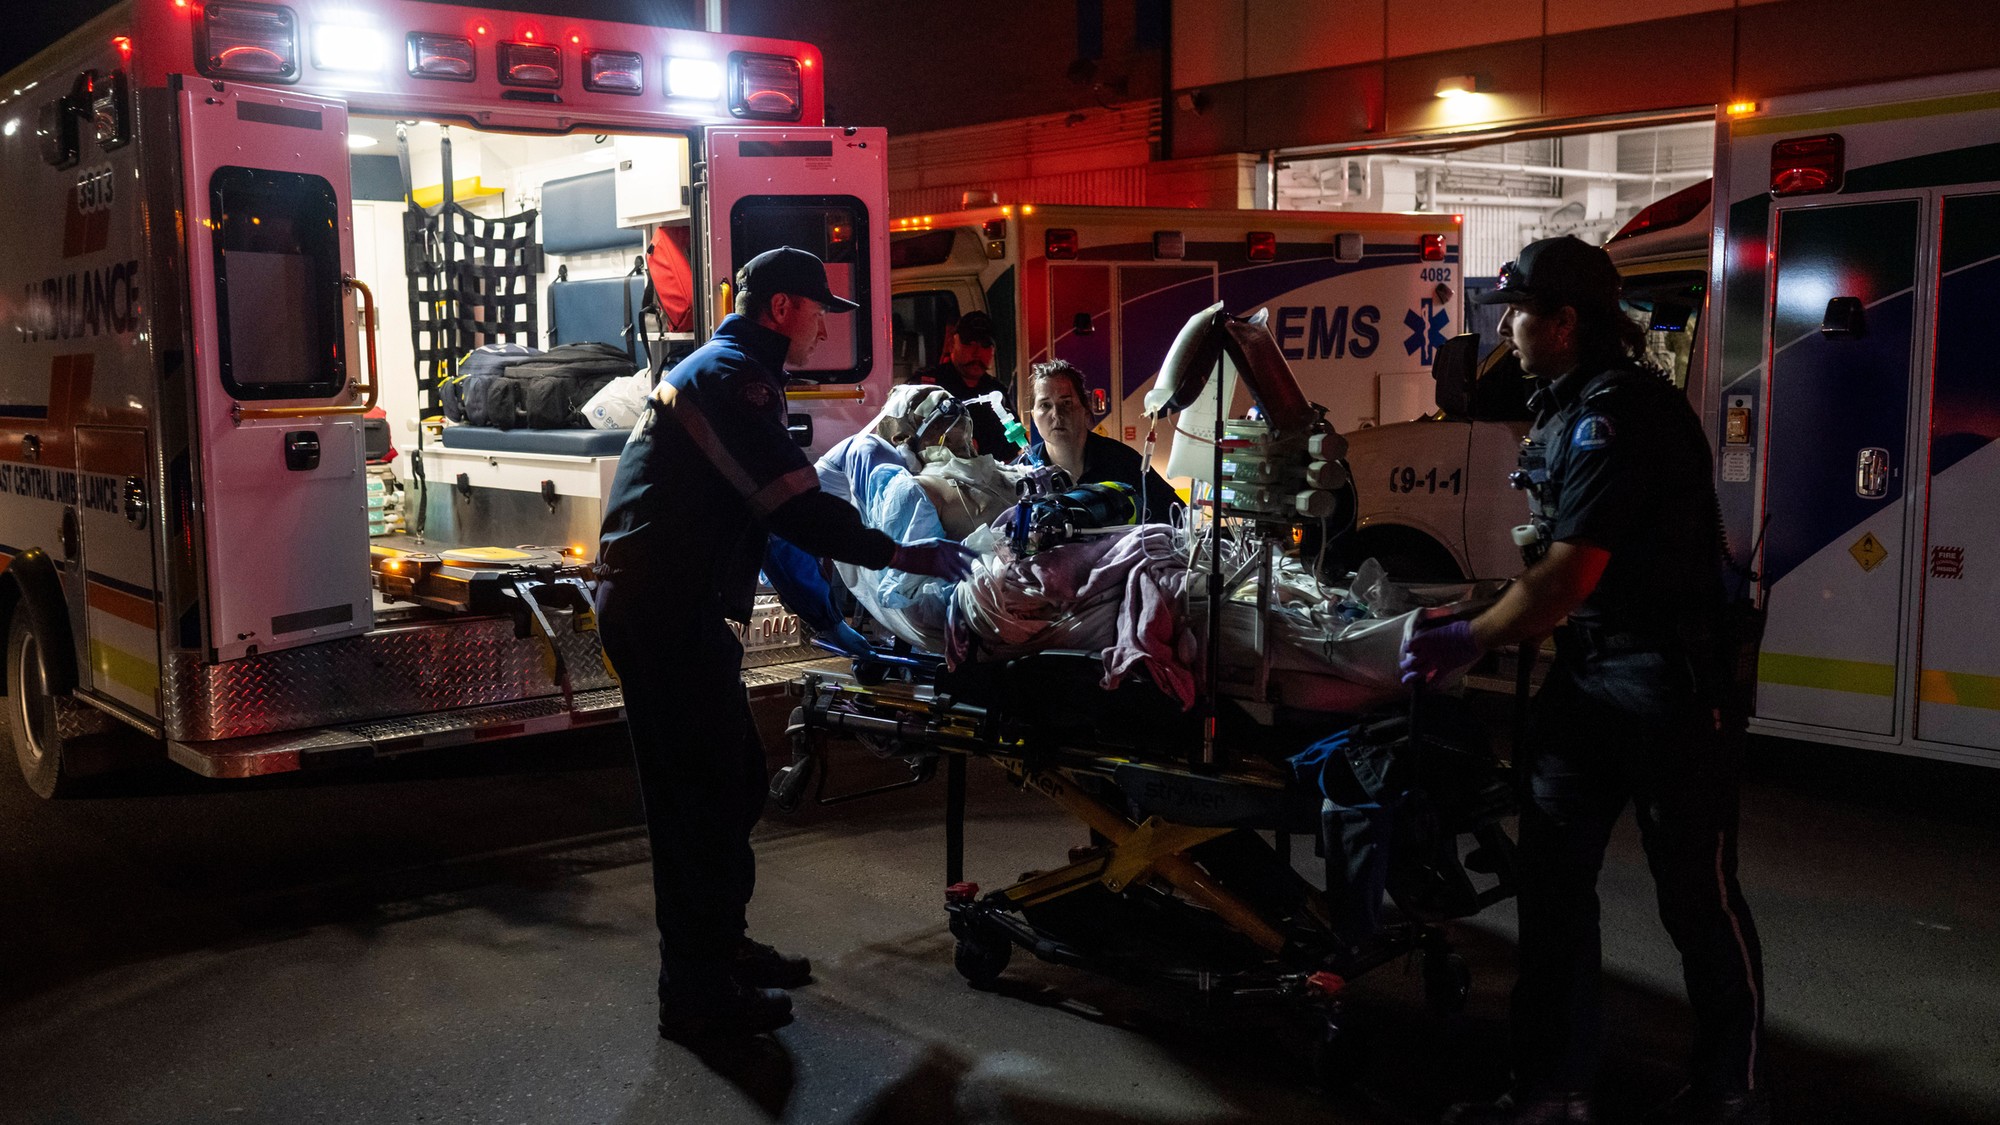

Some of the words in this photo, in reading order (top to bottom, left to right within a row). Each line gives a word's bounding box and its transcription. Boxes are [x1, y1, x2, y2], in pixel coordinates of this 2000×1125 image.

[1420, 268, 1451, 282] 4082
[1276, 305, 1381, 360] EMS
[0, 463, 11, 493] ST
[14, 465, 54, 501] CENTRAL
[57, 471, 118, 514] AMBLANCE
[728, 615, 798, 641] YT-0443
